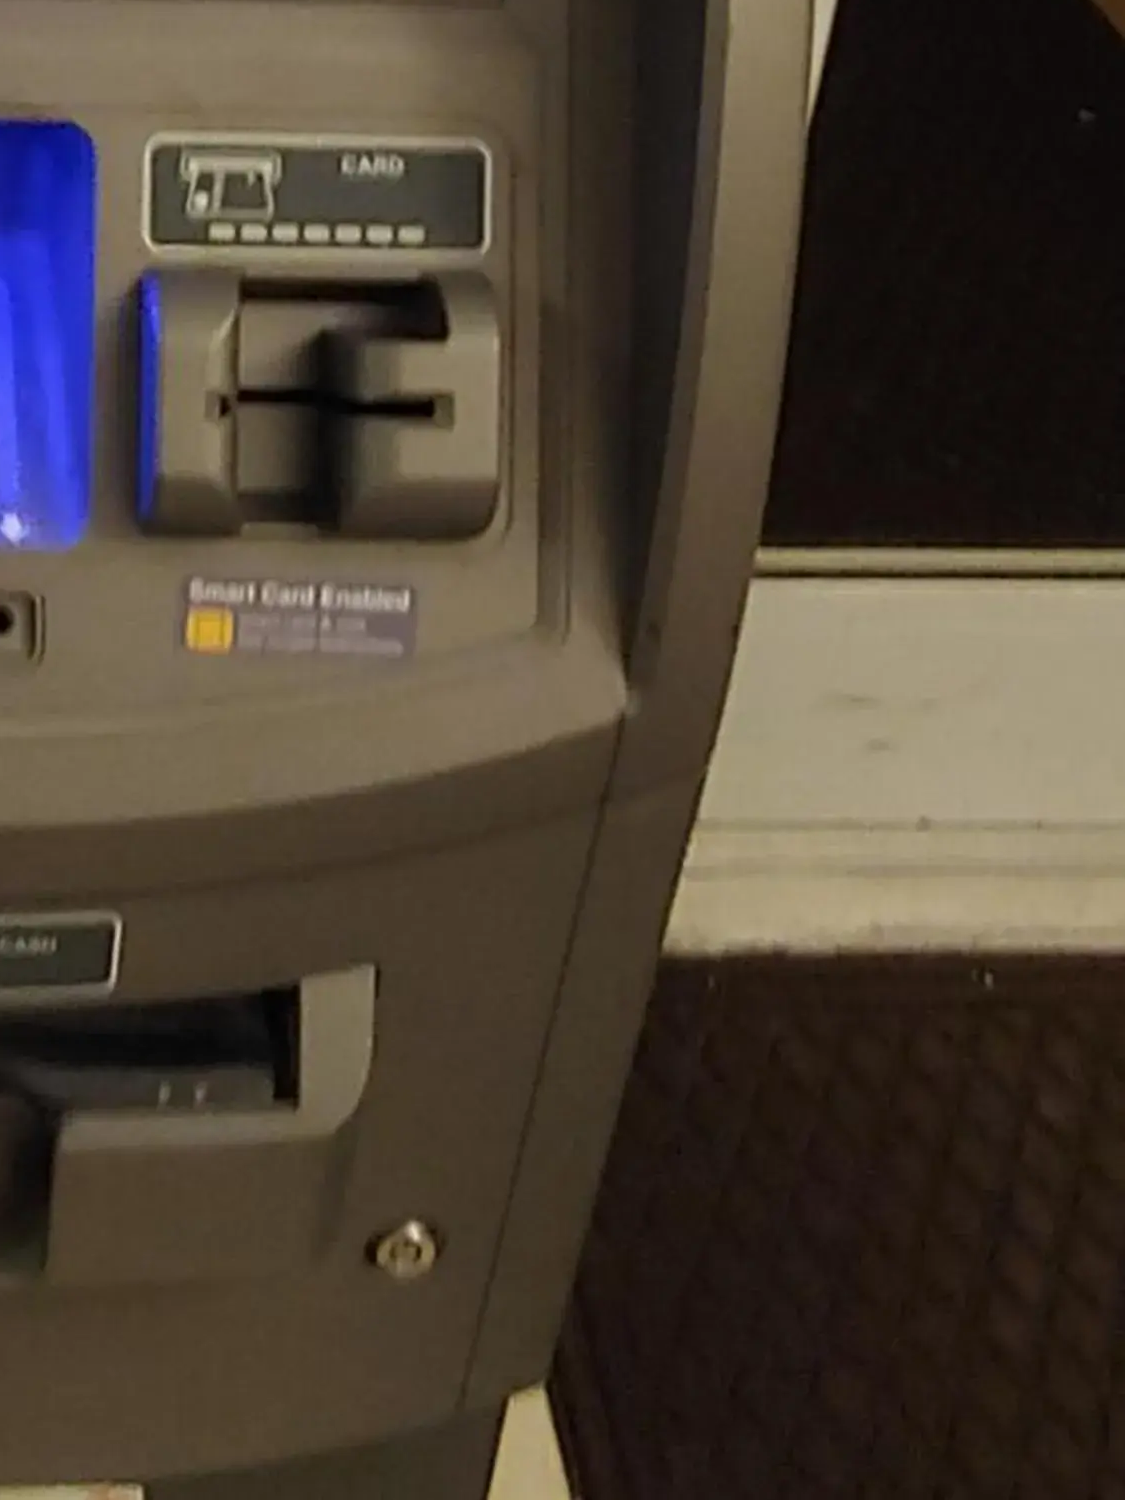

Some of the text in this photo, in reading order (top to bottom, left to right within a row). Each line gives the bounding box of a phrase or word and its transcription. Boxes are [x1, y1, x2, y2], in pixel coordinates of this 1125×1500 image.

[340, 153, 405, 176] CARD
[189, 576, 411, 614] Smart Card Enabled
